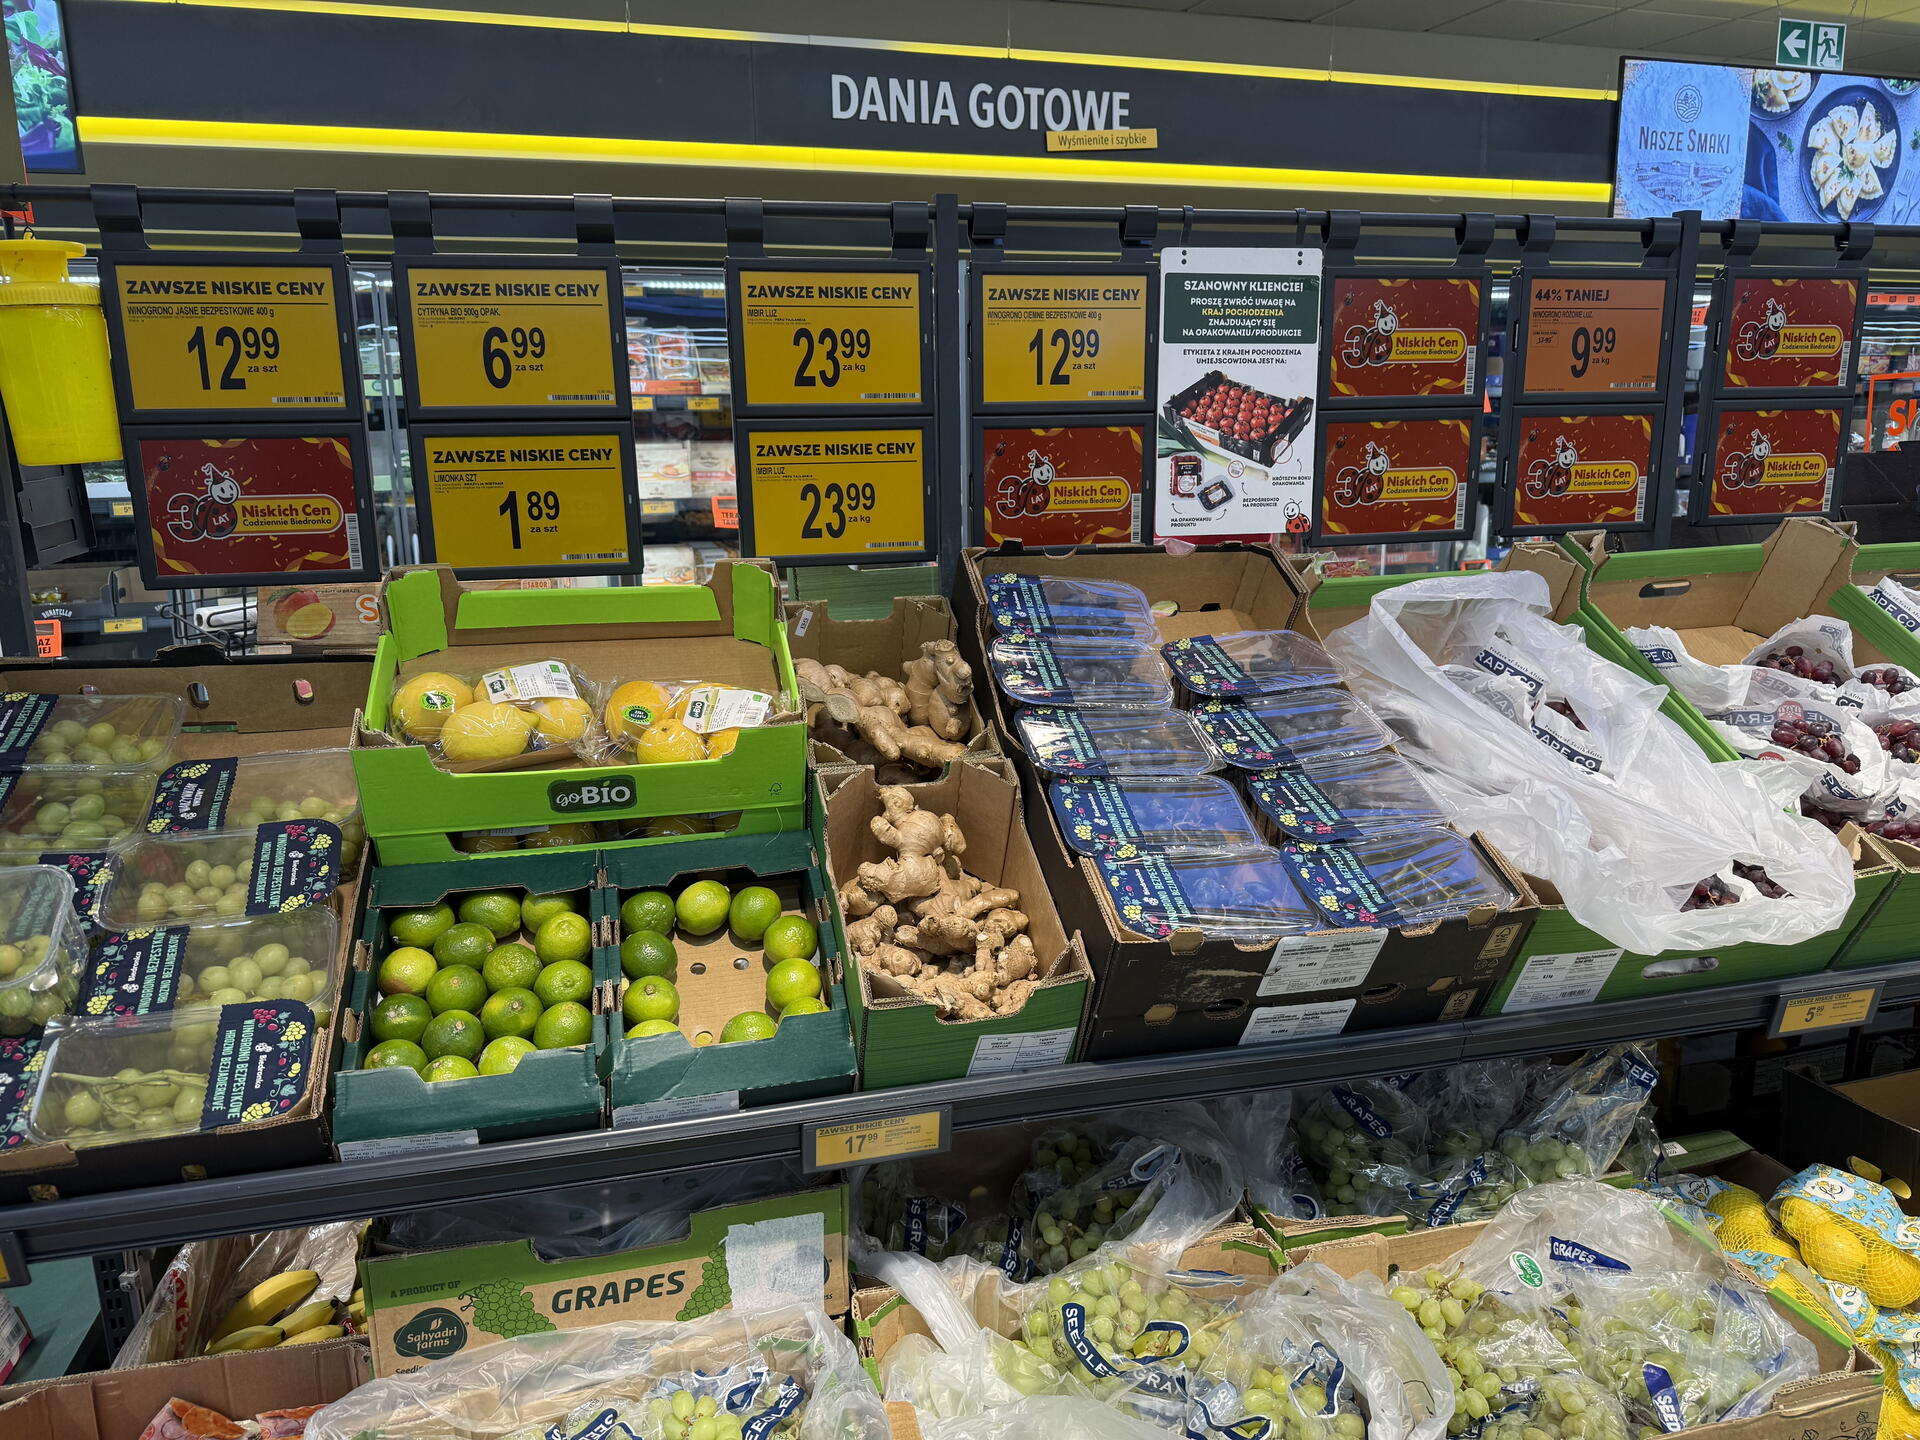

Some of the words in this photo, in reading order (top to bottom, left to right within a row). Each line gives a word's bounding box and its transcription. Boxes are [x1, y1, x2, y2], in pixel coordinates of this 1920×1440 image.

[831, 74, 959, 126] DANIA
[969, 82, 1130, 131] GOTOWE
[1058, 134, 1108, 148] Wyśmienite
[1110, 134, 1114, 145] i
[1116, 133, 1147, 145] szybkie
[1639, 126, 1682, 152] NASZE
[1687, 129, 1731, 154] SMAKI
[126, 280, 206, 295] ZAWSZE
[211, 281, 271, 295] NISKIE
[276, 282, 325, 295] CENY
[416, 283, 491, 296] ZAWSZE
[495, 284, 551, 296] NISKIE
[555, 284, 600, 297] CENY
[1184, 280, 1248, 291] SZANOWNY
[1249, 282, 1303, 292] KLIENCIE!
[747, 285, 814, 298] ZAWSZE
[818, 286, 868, 299] NISKIE
[872, 286, 912, 300] CENY
[988, 288, 1049, 300] ZAWSZE
[1054, 289, 1099, 300] NISKIE
[1102, 289, 1140, 301] CENY
[1535, 289, 1561, 301] 44%
[1565, 289, 1610, 301] TANIEJ
[1191, 298, 1222, 307] PROSZĘ
[1224, 296, 1254, 306] ZWRÓĆ
[1255, 298, 1283, 308] UWAGĘ
[128, 306, 173, 315] WINOGRONO
[175, 307, 199, 315] JASNE
[200, 307, 254, 315] BEZPESTKOWE
[256, 307, 268, 315] 400
[269, 308, 274, 317] g
[418, 308, 449, 316] CYTRYNA
[451, 308, 462, 316] BIO
[464, 308, 479, 318] 500g
[480, 308, 500, 316] OPAK.
[747, 309, 764, 317] IMBIR
[765, 309, 777, 317] LUZ
[987, 311, 1022, 319] WINOGRONO
[1023, 311, 1045, 319] CIEMNE
[1098, 313, 1101, 321] g
[1202, 308, 1224, 316] KRAJ
[1208, 318, 1261, 328] ZNAJDUJĄCY
[1263, 319, 1276, 328] SIĘ
[1196, 329, 1301, 337] OPAKOWANIU/PRODUKCIE
[1782, 332, 1818, 343] Niskich
[1819, 332, 1836, 343] Cen
[1396, 337, 1436, 347] Niskich
[1438, 337, 1458, 347] Cen
[1764, 339, 1775, 349] LAT
[1375, 344, 1387, 354] LAT
[529, 363, 544, 371] szt
[1601, 357, 1610, 365] kg
[247, 365, 259, 373] za
[262, 364, 278, 373] szt
[854, 363, 866, 372] kg
[756, 444, 821, 457] ZAWSZE
[825, 443, 873, 456] NISKIE
[876, 442, 915, 455] CENY
[433, 450, 506, 464] ZAWSZE
[510, 449, 565, 462] NISKIE
[568, 448, 612, 461] CENY
[756, 467, 773, 475] IMBIR
[1767, 461, 1802, 471] Niskich
[1803, 460, 1820, 471] Cen
[1574, 468, 1611, 479] Niskich
[1612, 468, 1631, 479] Cen
[1749, 467, 1760, 477] LAT
[433, 474, 464, 483] LIMONKA
[466, 474, 477, 482] SZT
[1387, 476, 1427, 487] Niskich
[1429, 475, 1449, 485] Cen
[1555, 476, 1567, 486] LAT
[1054, 486, 1097, 497] Niskich
[1100, 485, 1122, 496] Cen
[1366, 483, 1379, 494] LAT
[1031, 493, 1044, 505] LAT
[241, 504, 299, 517] Niskich
[302, 504, 331, 516] Cen
[212, 513, 230, 527] LAT
[860, 514, 871, 524] kg
[543, 525, 558, 533] szt
[1532, 727, 1571, 760] RAPE
[555, 786, 631, 807] goBIO
[220, 1028, 236, 1056] HROZNO
[236, 1017, 255, 1062] WINOGRONO
[253, 1053, 267, 1089] Biedronka
[226, 1062, 247, 1120] BEZPESTKOWE
[820, 1126, 854, 1135] ZAWSZE
[856, 1121, 882, 1130] NISKIE
[884, 1118, 906, 1126] CENY
[1552, 1242, 1596, 1265] GRAPES
[400, 1283, 447, 1297] PRODUCT
[450, 1280, 461, 1290] OF
[551, 1269, 686, 1315] GRAPES
[407, 1327, 457, 1343] Sahyadri
[417, 1339, 449, 1351] farms
[1065, 1307, 1120, 1379] SEEDLES
